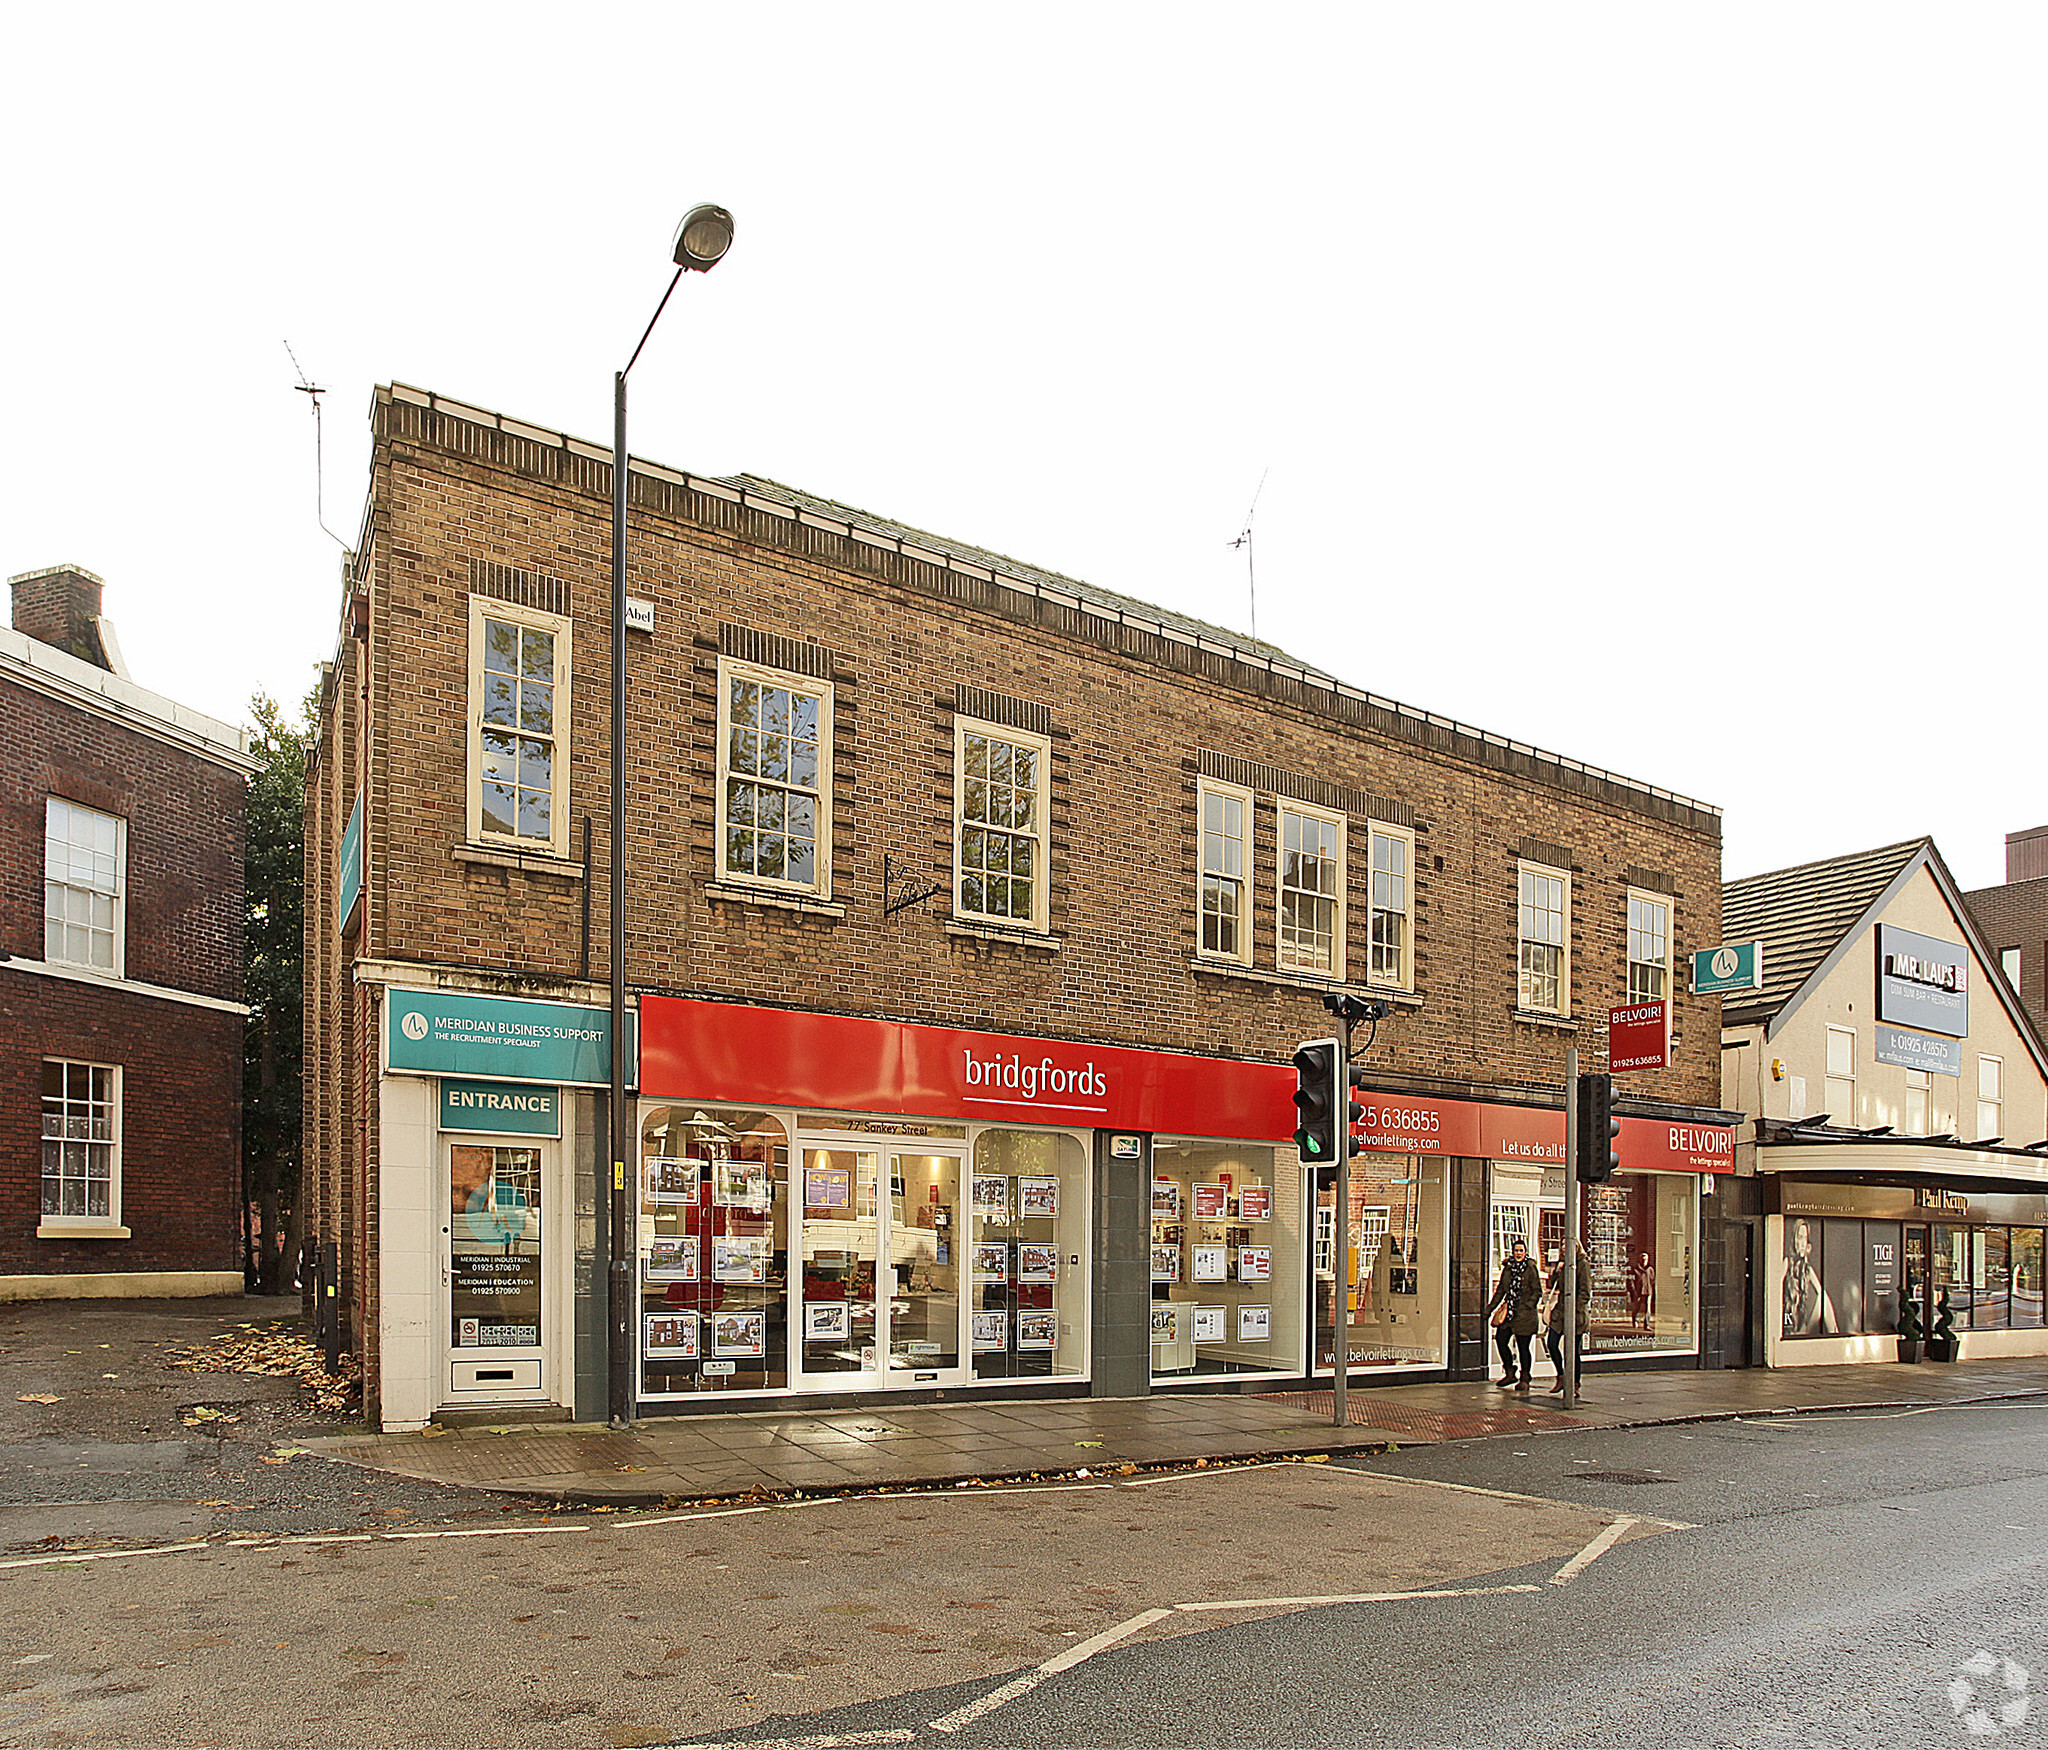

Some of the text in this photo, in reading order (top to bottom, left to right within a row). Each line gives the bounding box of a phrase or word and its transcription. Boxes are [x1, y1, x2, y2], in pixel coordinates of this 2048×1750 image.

[625, 607, 650, 623] Abel
[1923, 959, 1954, 987] LAU'S
[1903, 987, 1915, 999] SUM
[1916, 990, 1927, 1001] BAR
[1931, 993, 1960, 1009] RESTAURANT
[1612, 1005, 1662, 1024] BELVOIR!
[434, 1016, 604, 1042] MERIDIAN BUSINESS SUPPORT
[434, 1032, 541, 1048] THE RECRUITMENT SPECIALIST
[1897, 1034, 1921, 1053] 01925
[1612, 1054, 1662, 1068] 01925 636855
[963, 1049, 1107, 1099] bridgfords
[448, 1091, 551, 1113] ENTRANCE
[847, 1121, 928, 1136] 77 Sankey Street
[1381, 1107, 1440, 1132] 636855
[1351, 1131, 1440, 1151] elvoirlettings.com
[1502, 1138, 1519, 1155] Let
[1520, 1144, 1531, 1156] us
[1532, 1141, 1545, 1157] do
[1545, 1143, 1558, 1158] all
[1669, 1127, 1732, 1154] BELVOIR!
[1922, 1188, 1970, 1216] Paul Kemp
[472, 1263, 494, 1271] 01925
[472, 1287, 520, 1295] 01925 570900
[1595, 1334, 1676, 1349] www.belvoirlettings.com
[1324, 1347, 1433, 1363] ww.belvoirlettings.com
